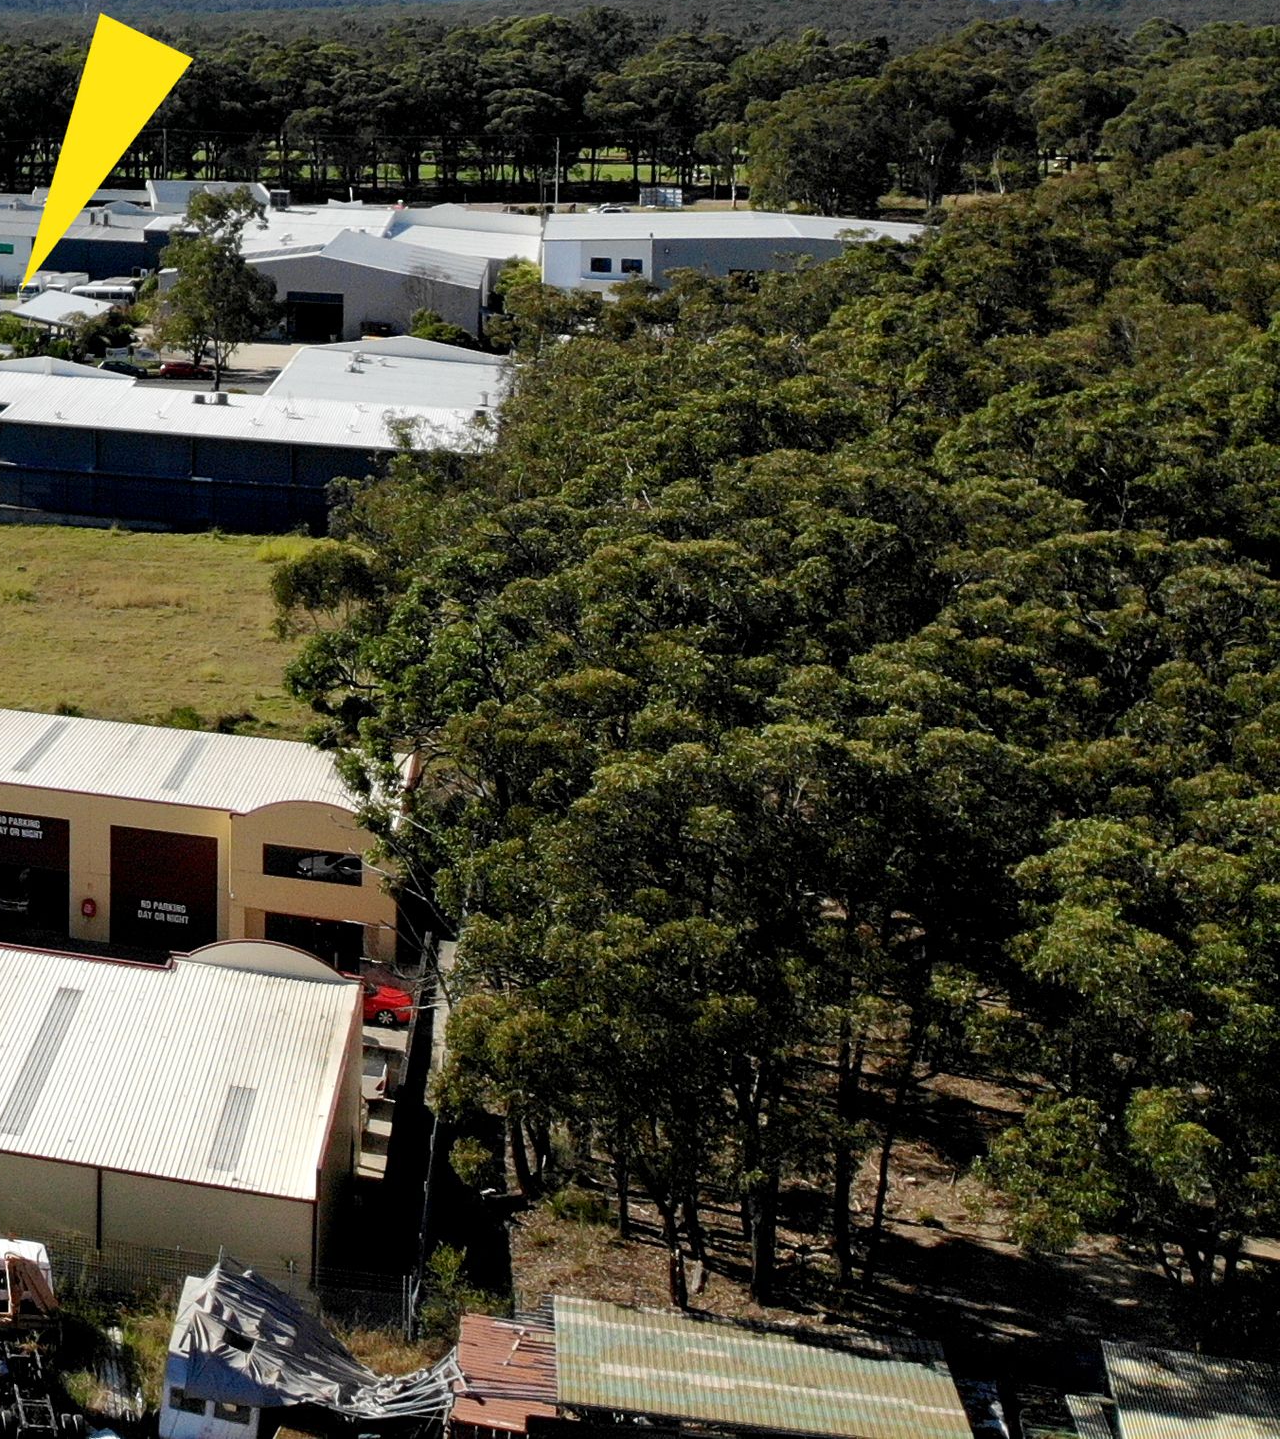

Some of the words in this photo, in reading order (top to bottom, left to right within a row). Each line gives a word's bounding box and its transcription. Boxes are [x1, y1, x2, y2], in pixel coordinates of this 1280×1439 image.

[8, 816, 41, 829] PARKING
[9, 827, 20, 836] OR
[140, 900, 151, 909] NO
[137, 909, 152, 919] DAY
[154, 912, 165, 922] OR
